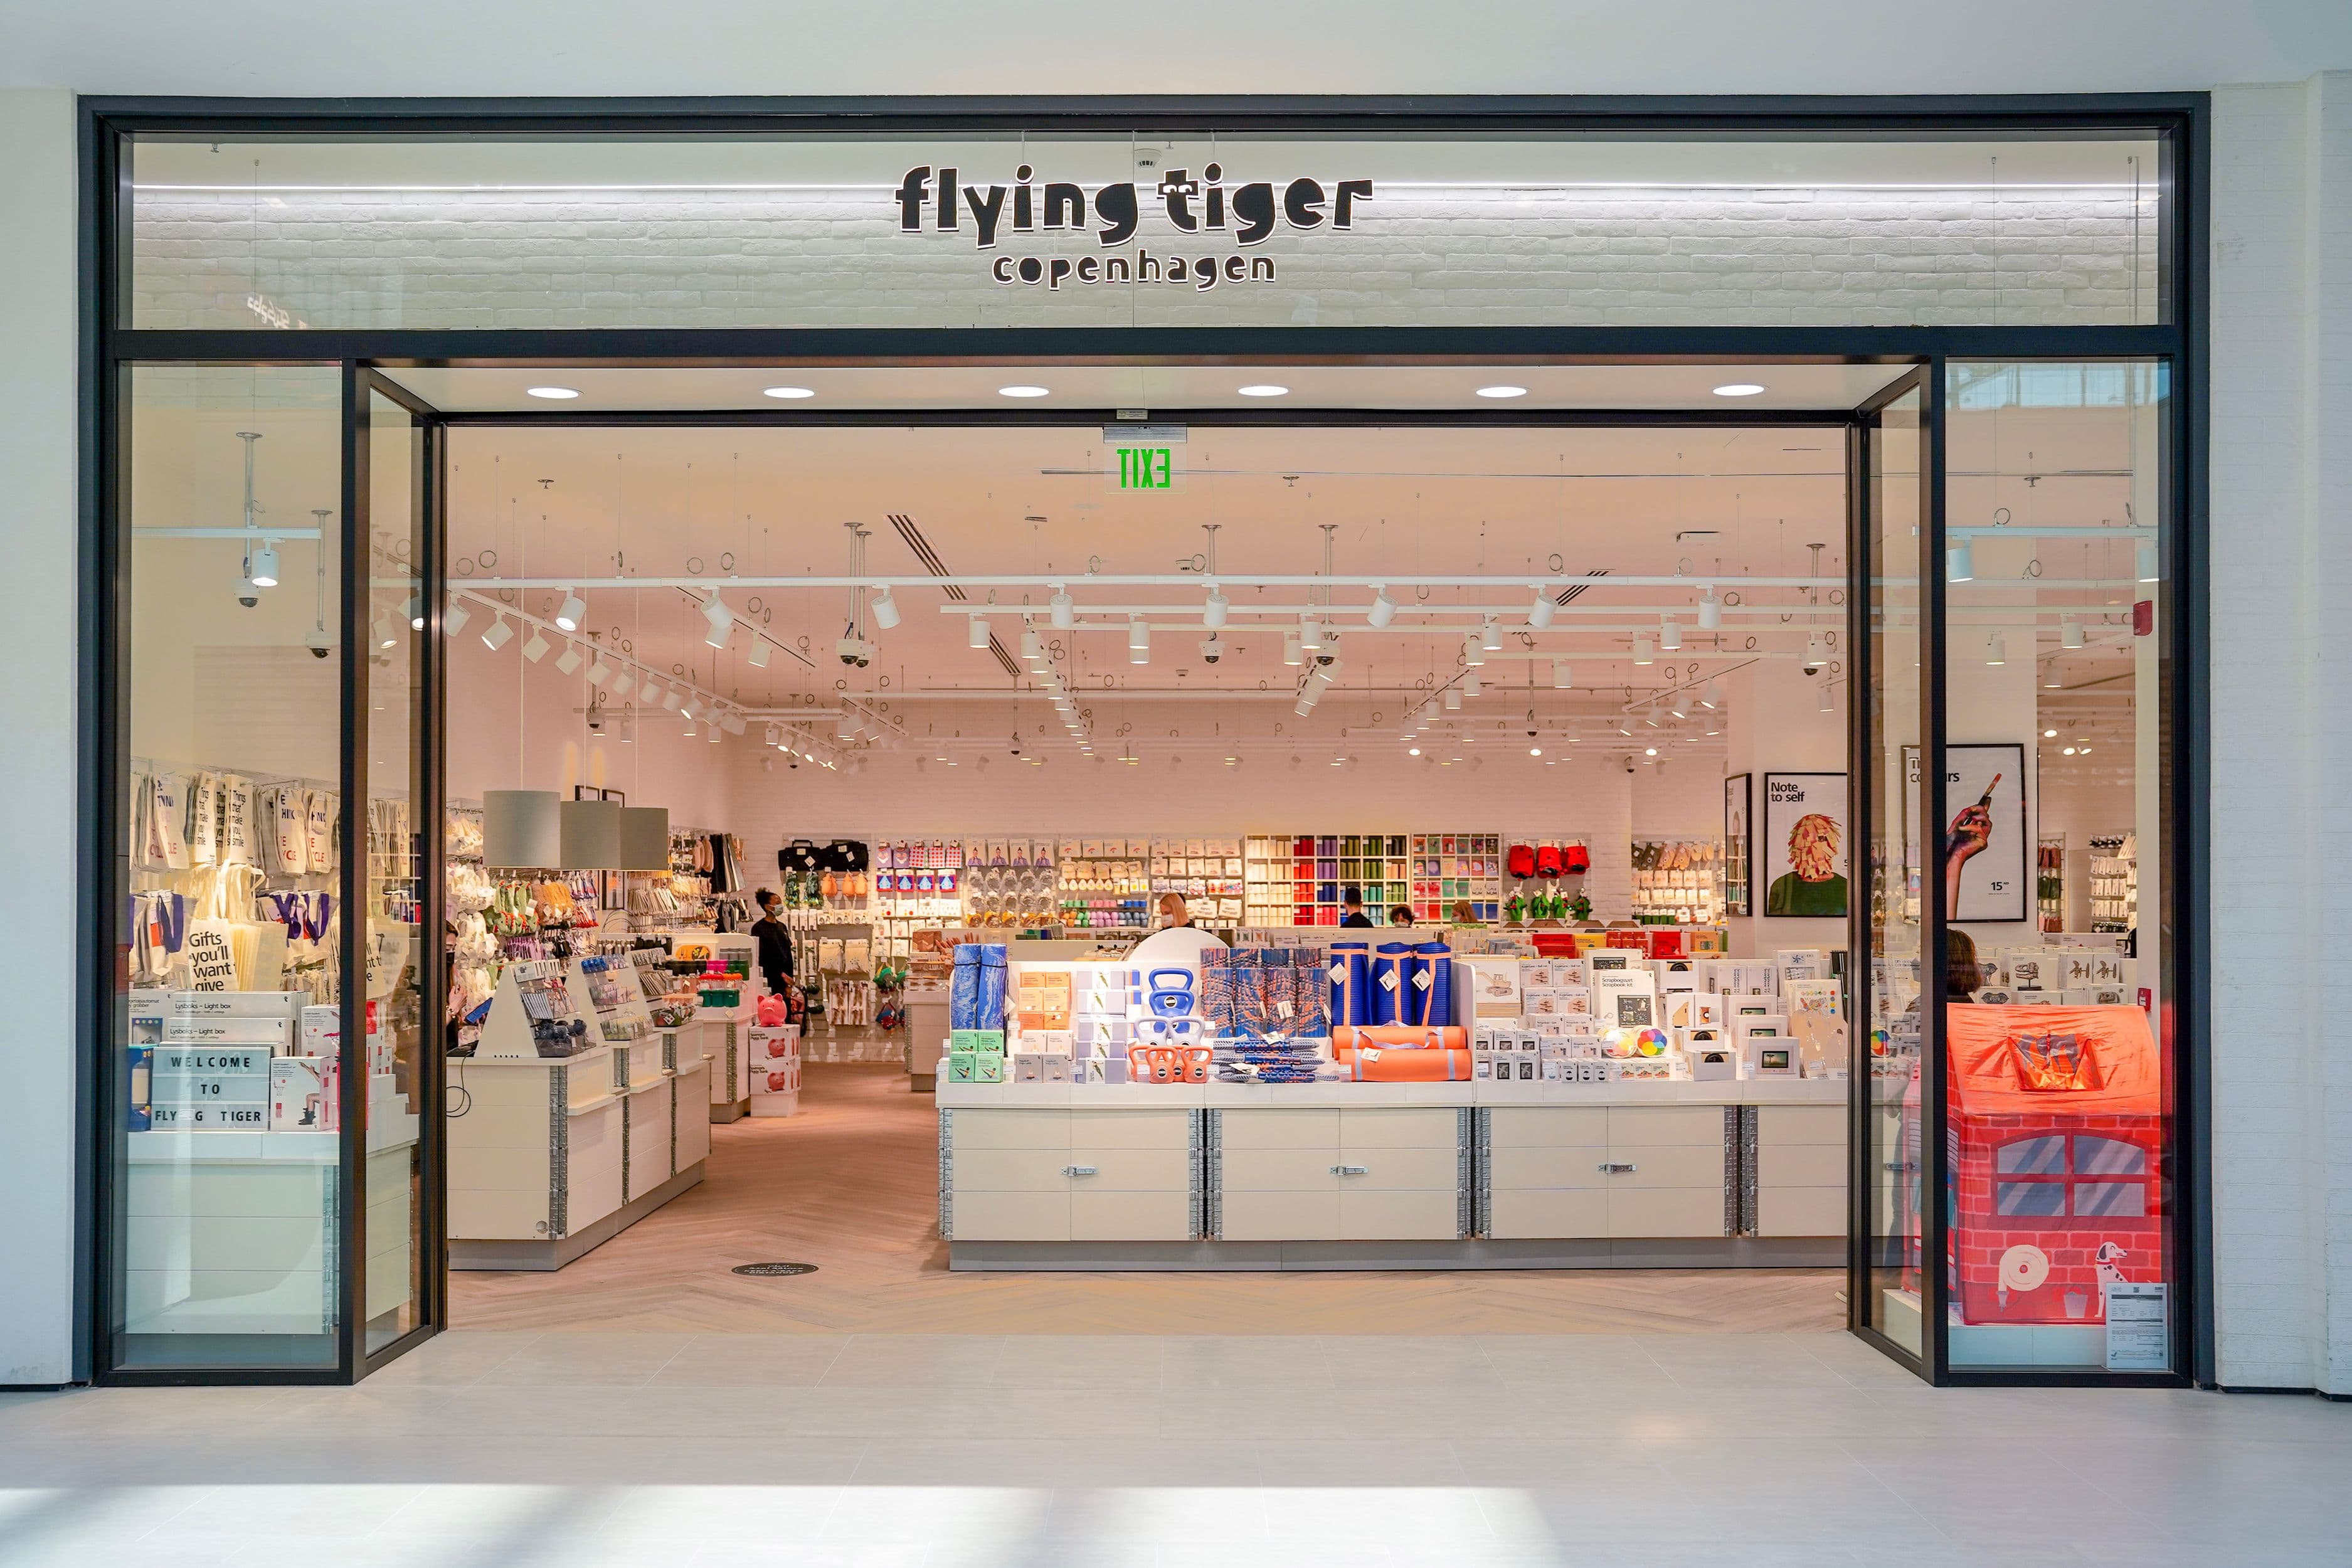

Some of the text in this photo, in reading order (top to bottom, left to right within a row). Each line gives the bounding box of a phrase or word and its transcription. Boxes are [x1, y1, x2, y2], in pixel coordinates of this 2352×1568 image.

[894, 162, 1374, 249] flying tiger
[992, 248, 1276, 292] copenhagen
[1771, 782, 1798, 792] Note
[1771, 791, 1805, 802] to self
[1991, 882, 2003, 891] 15
[189, 931, 222, 947] Gifts
[193, 962, 232, 978] want
[195, 978, 224, 992] give
[171, 1057, 250, 1067] WELCOME
[201, 1084, 220, 1094] TO
[221, 1111, 261, 1121] TIGER
